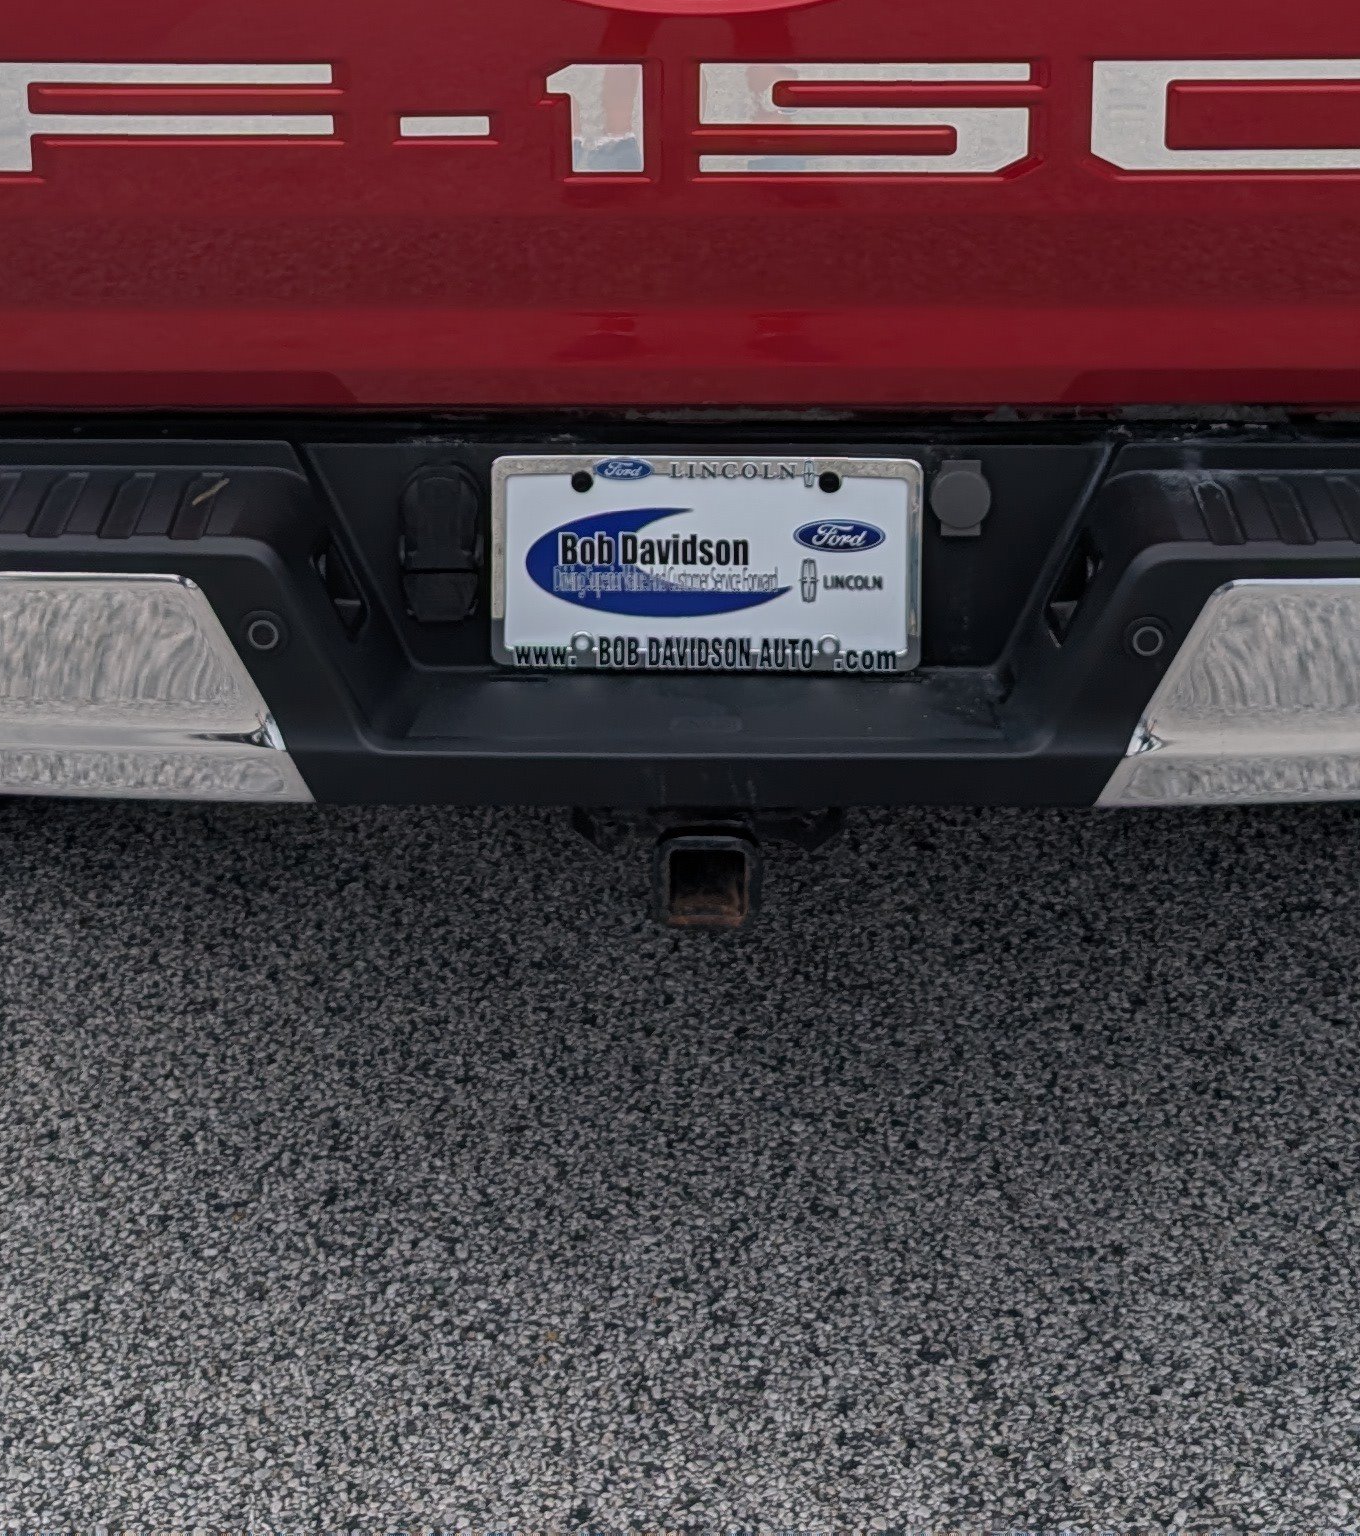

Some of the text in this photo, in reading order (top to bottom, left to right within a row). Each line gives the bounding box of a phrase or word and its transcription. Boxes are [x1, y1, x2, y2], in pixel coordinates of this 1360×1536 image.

[603, 461, 644, 477] Ford
[669, 461, 798, 480] LINCOLN
[811, 523, 867, 547] Ford
[558, 531, 750, 567] Bob Davidson
[822, 574, 884, 591] LINCOLN
[597, 634, 639, 668] BOB
[648, 635, 752, 670] DAVIDSON
[759, 637, 815, 671] AUTO
[834, 649, 898, 672] .com
